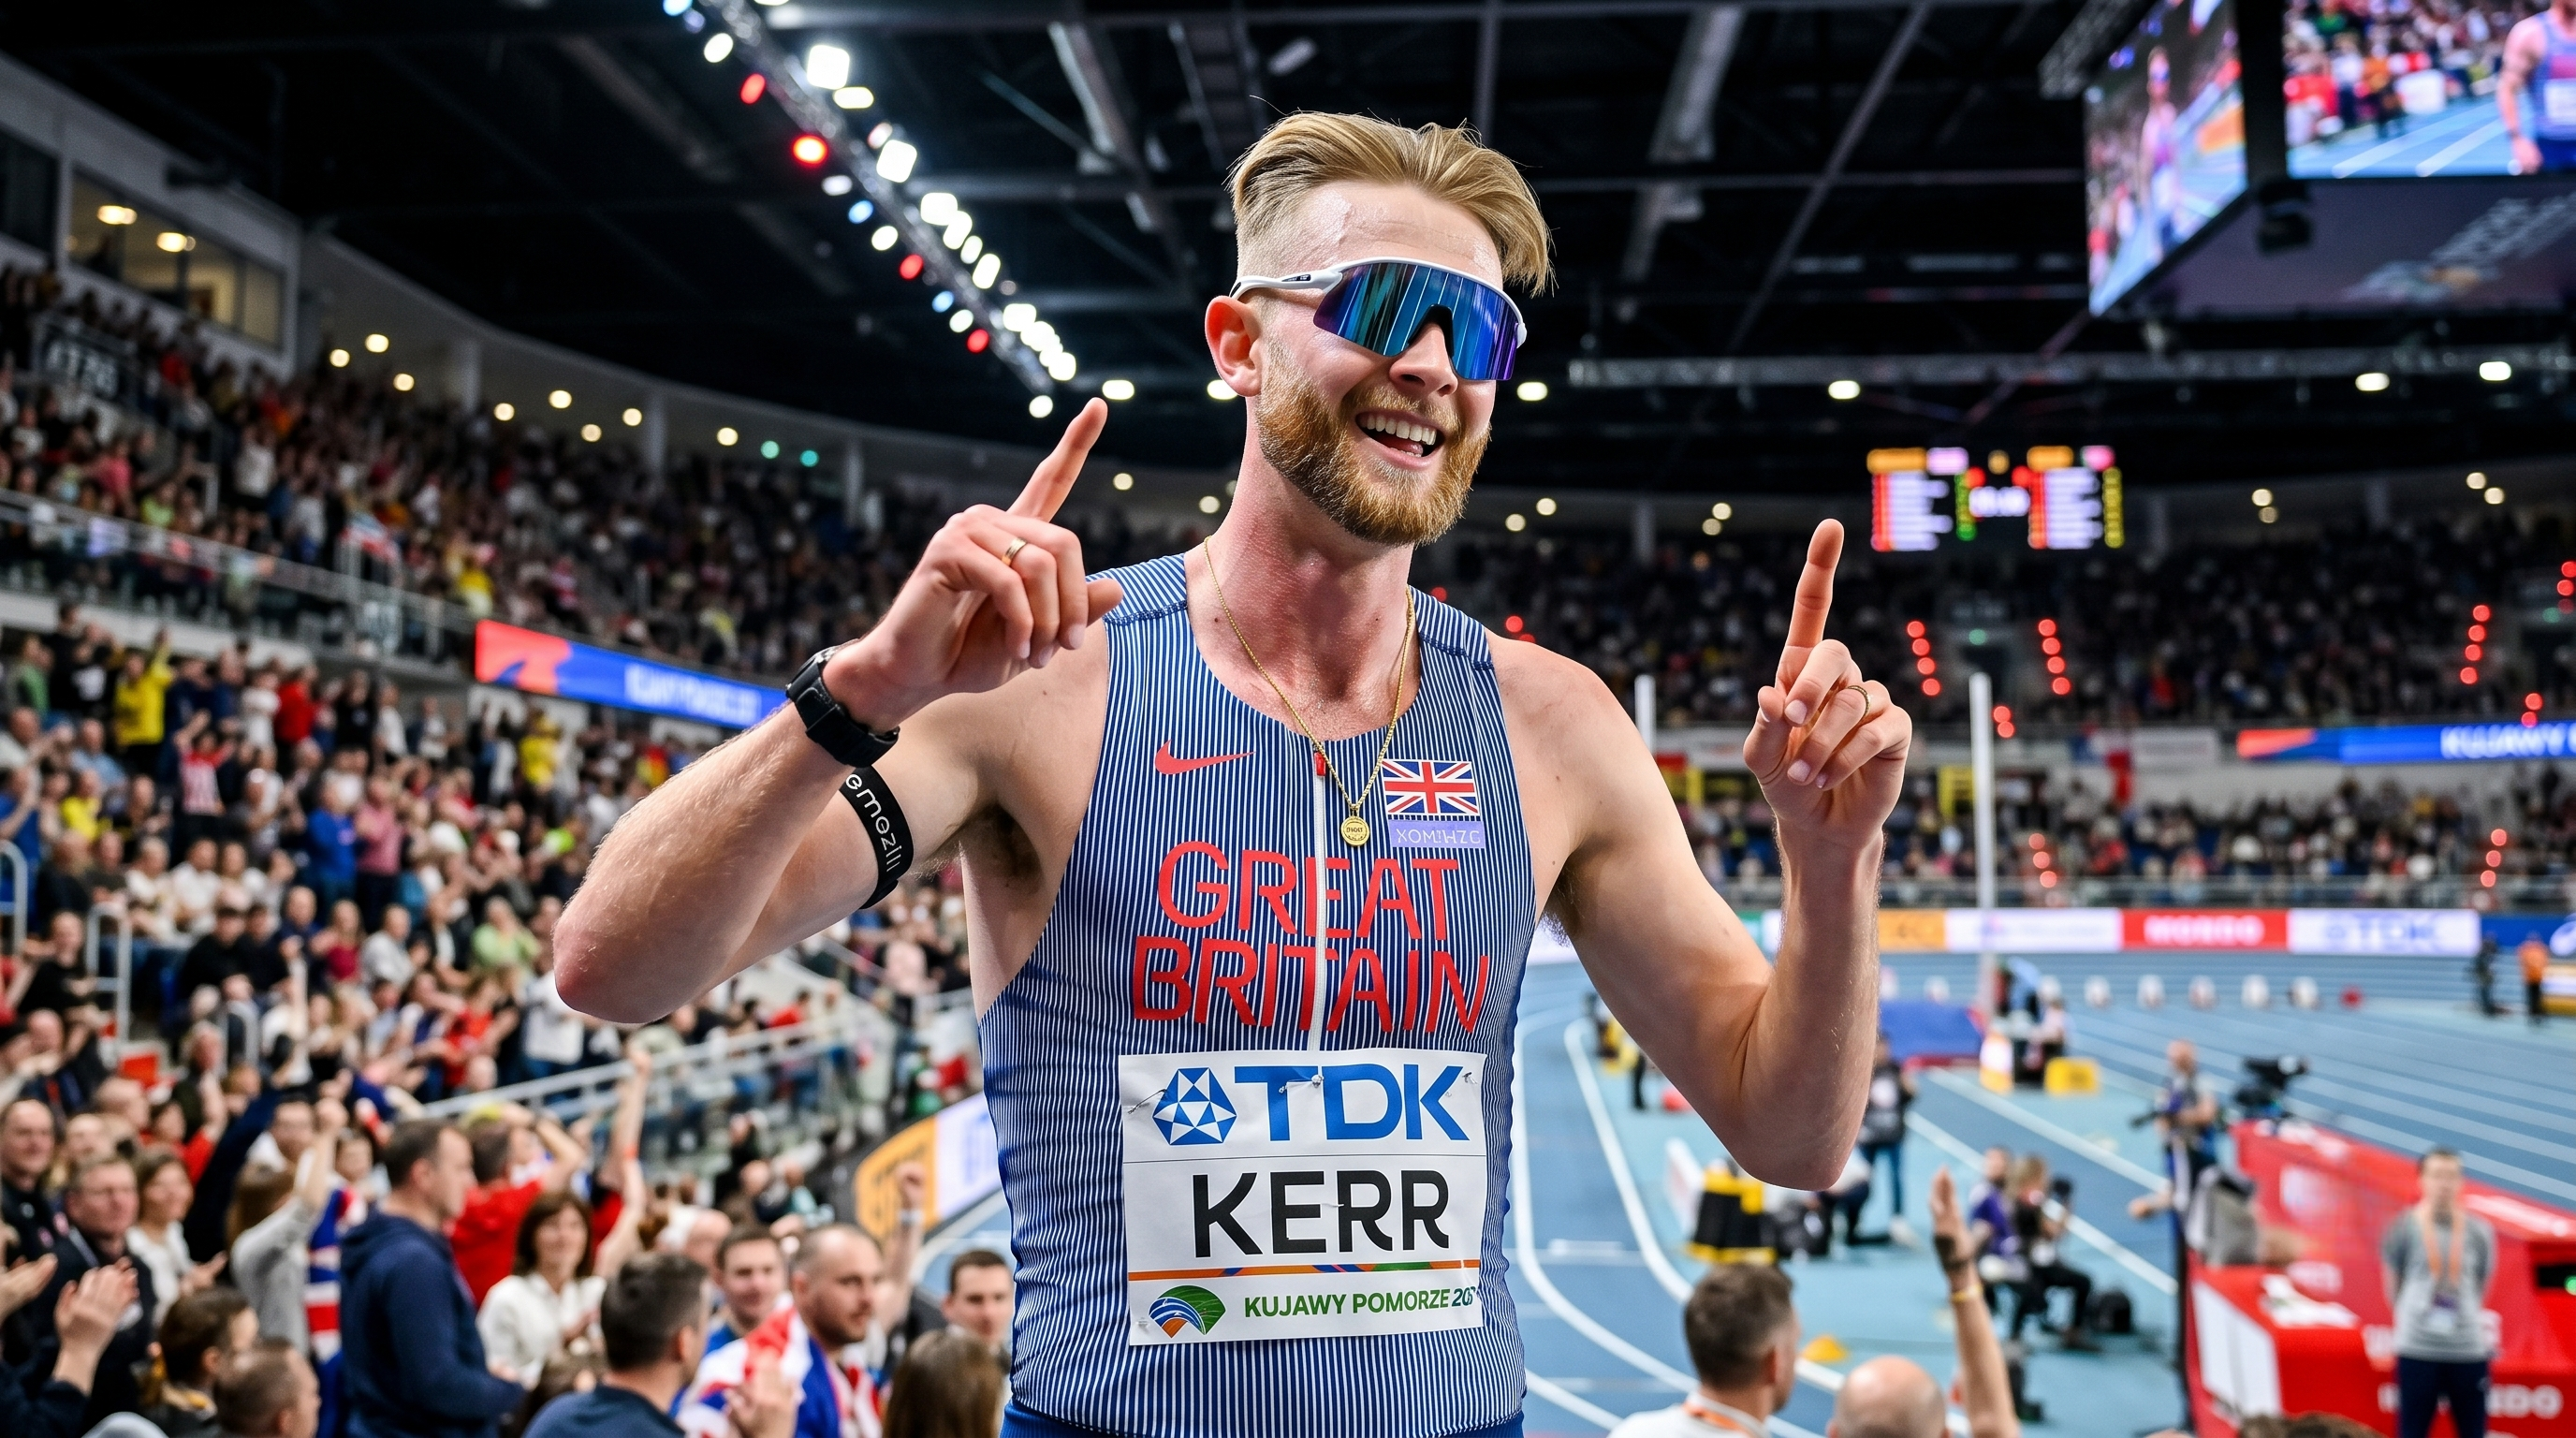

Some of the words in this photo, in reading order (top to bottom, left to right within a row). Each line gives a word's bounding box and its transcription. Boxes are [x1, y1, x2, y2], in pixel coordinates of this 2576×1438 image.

[1157, 841, 1458, 941] GREAT
[1133, 935, 1489, 1034] BRITAIN
[1234, 1063, 1471, 1142] TDK
[1193, 1169, 1450, 1258] KERR
[1244, 1294, 1347, 1318] KUJAWY
[1353, 1288, 1451, 1314] POMORZE
